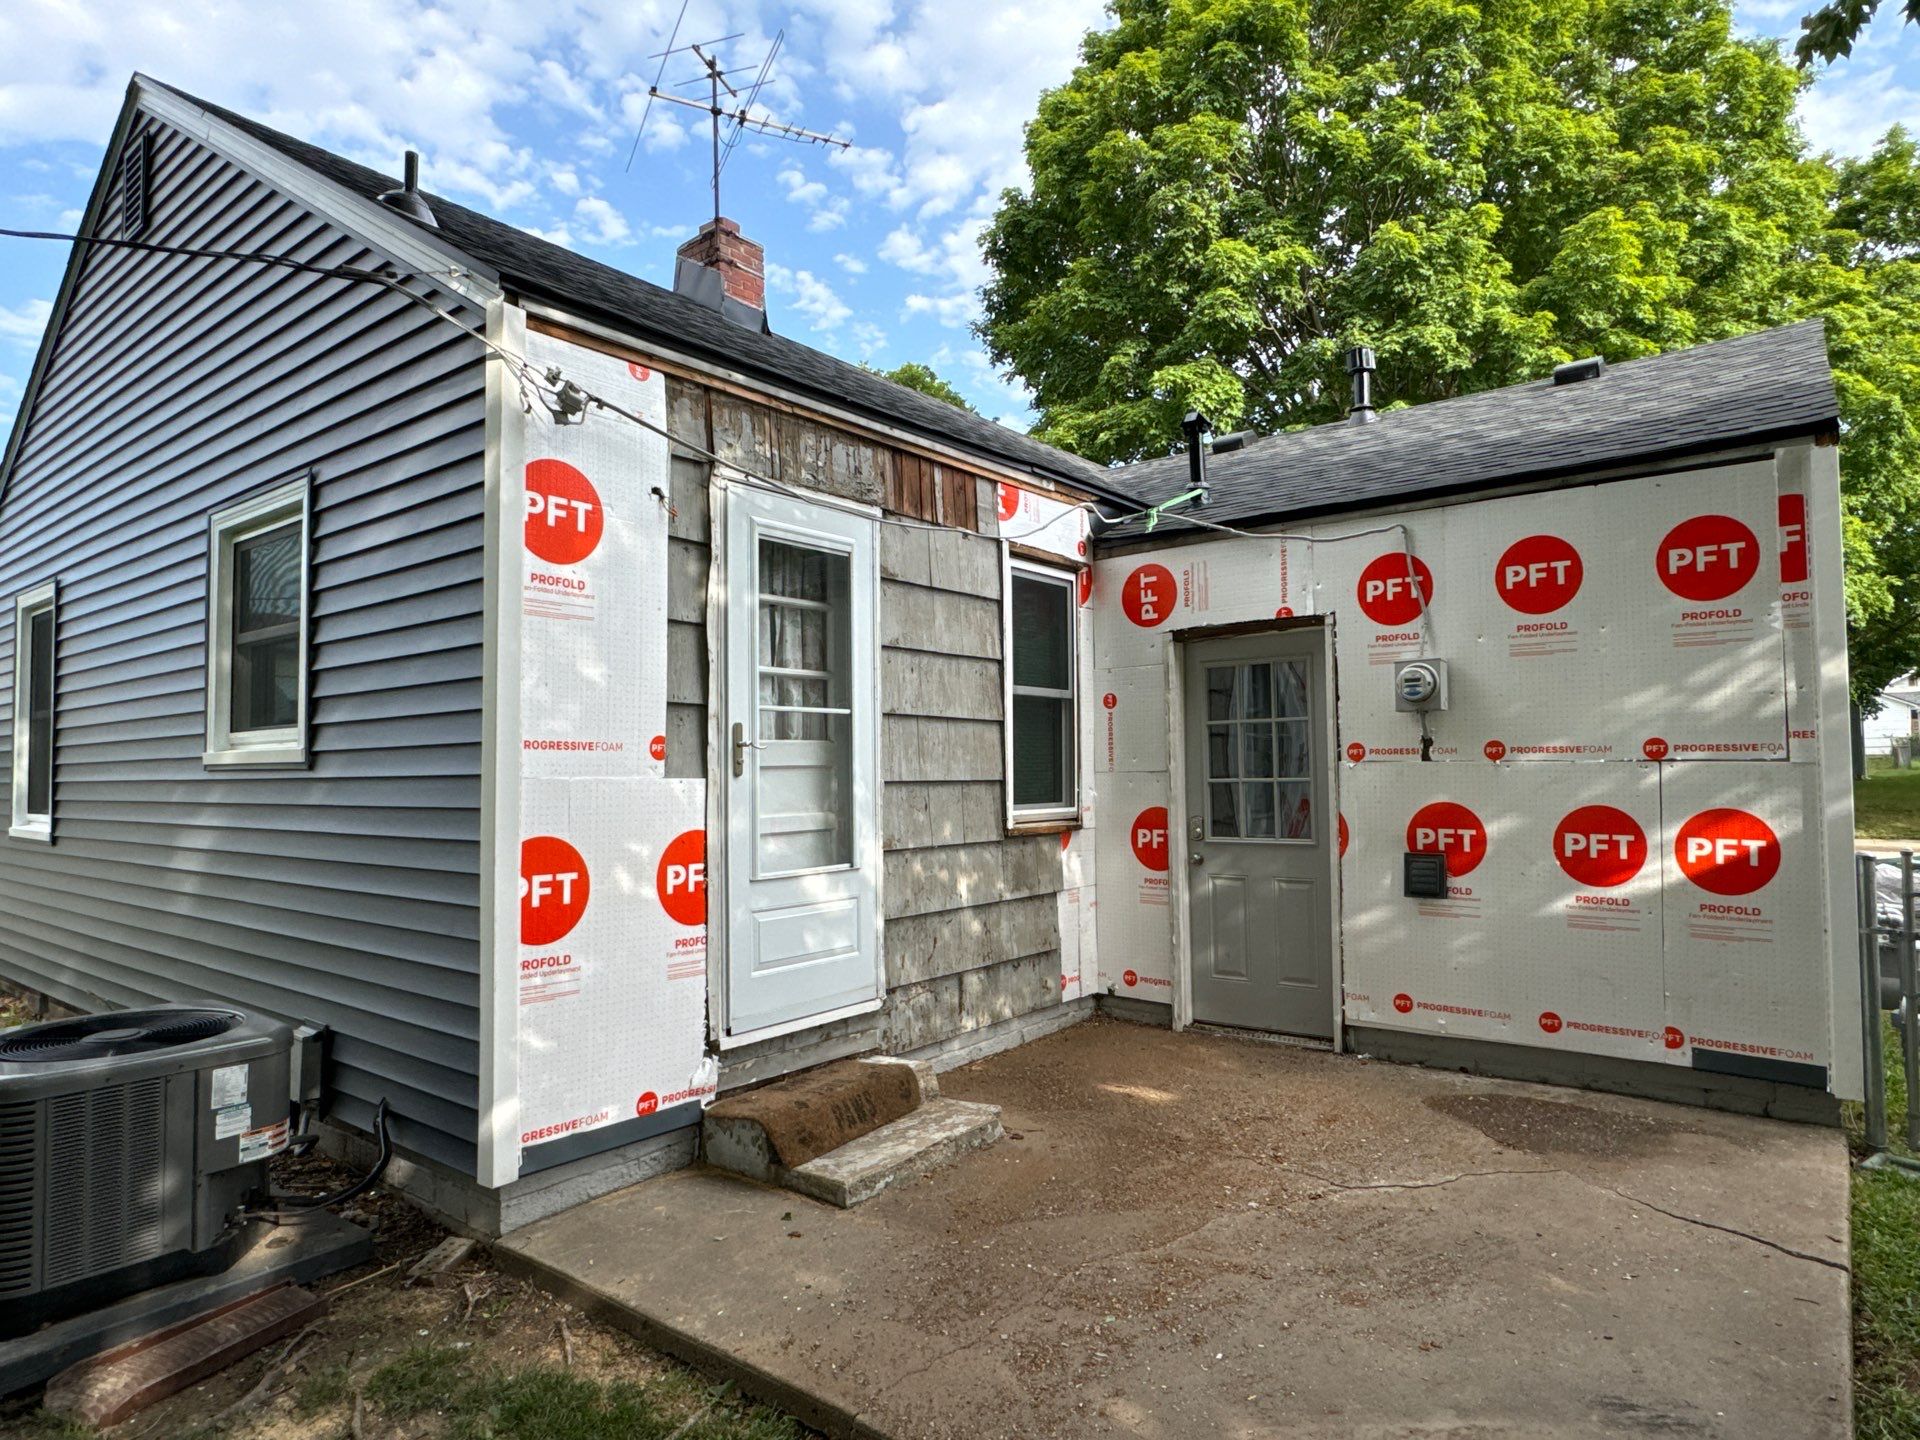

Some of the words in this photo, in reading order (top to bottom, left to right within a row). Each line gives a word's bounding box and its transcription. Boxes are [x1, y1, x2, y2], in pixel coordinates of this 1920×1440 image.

[1668, 541, 1746, 575] PFT
[531, 573, 586, 591] PROFOLD
[1505, 560, 1572, 590] PFT
[1141, 572, 1159, 620] PFT
[1366, 576, 1423, 603] PFT
[1681, 608, 1742, 621] PROFOLD
[1375, 632, 1420, 643] PROFOLD
[1516, 621, 1568, 633] PROFOLD
[1486, 746, 1504, 754] PFT
[1510, 745, 1613, 754] PROGRESSIVEFOAM
[1646, 744, 1666, 753] PFT
[1416, 828, 1477, 852] PFT
[1564, 832, 1635, 860] PFT
[1687, 837, 1767, 867] PFT
[1575, 895, 1631, 907] PROFOLD
[1700, 903, 1762, 917] PROFOLD
[1396, 999, 1411, 1009] PFT
[1417, 1001, 1512, 1021] PROGRESSIVEFOAM
[1690, 1036, 1814, 1061] PROGRESSIVEFOAM
[638, 1099, 657, 1112] PFT
[521, 1111, 609, 1143] GRESSIVEFOAM
